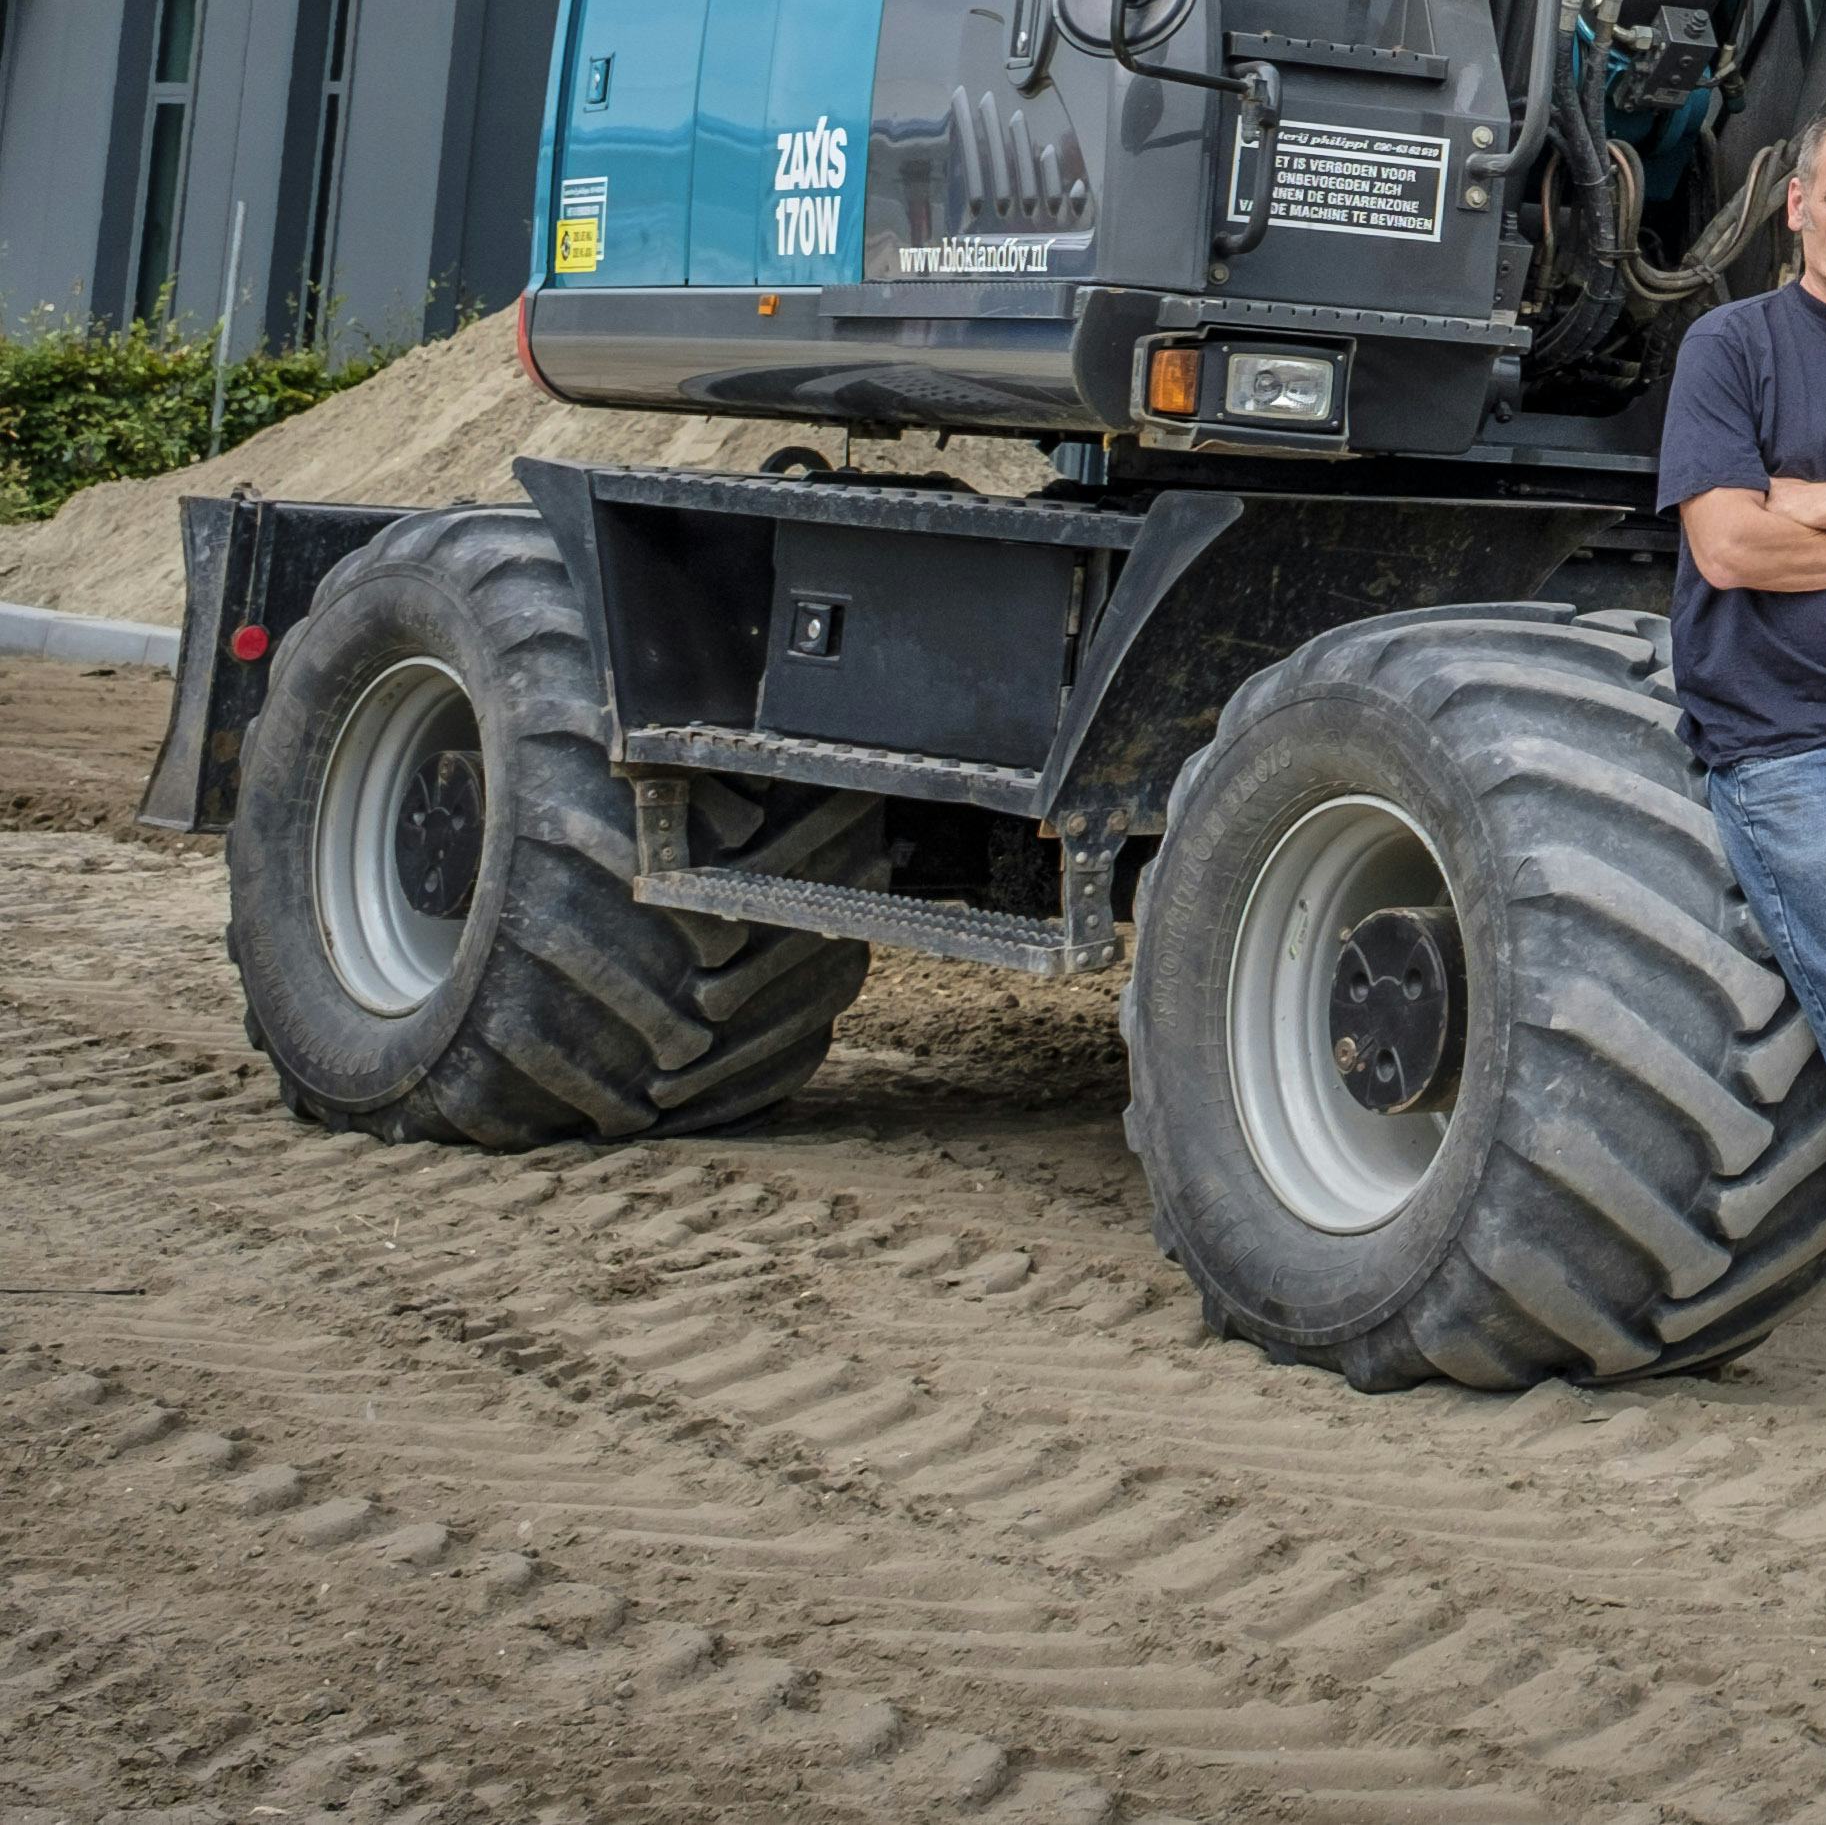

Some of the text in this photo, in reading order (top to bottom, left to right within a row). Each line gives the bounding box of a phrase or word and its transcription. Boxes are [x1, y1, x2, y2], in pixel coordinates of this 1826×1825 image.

[774, 115, 848, 191] ZAXIS
[1274, 155, 1417, 183] ET IS VERBODEN VOOR
[1276, 171, 1403, 196] ONBEVOEGDEN ZICH
[1306, 189, 1326, 204] DE
[1326, 192, 1420, 215] GEVARENZONE
[775, 195, 841, 256] 170W
[1288, 203, 1349, 227] MACHINE
[1351, 210, 1368, 224] TE
[1369, 212, 1433, 231] BEVINDEN
[899, 236, 1056, 273] www.bloklandbv.nl
